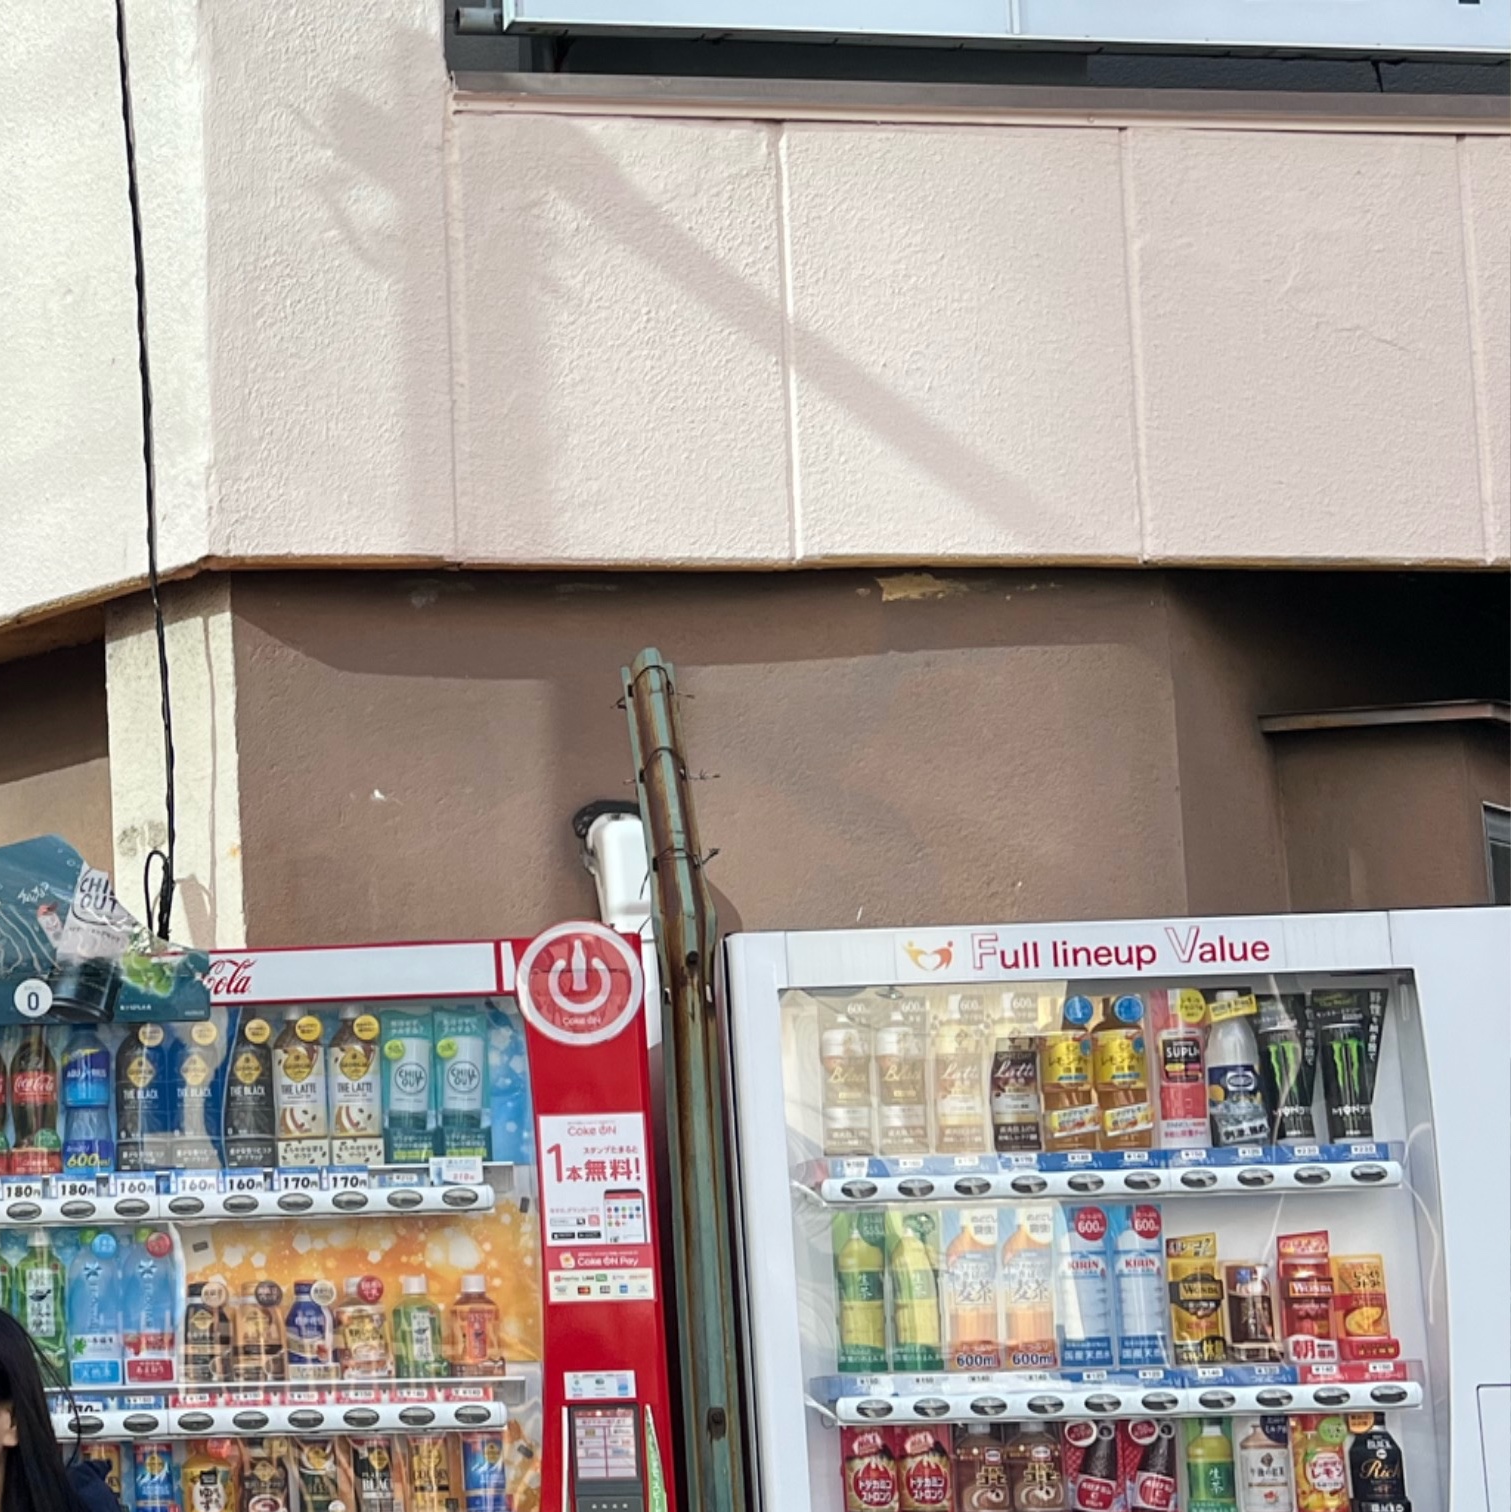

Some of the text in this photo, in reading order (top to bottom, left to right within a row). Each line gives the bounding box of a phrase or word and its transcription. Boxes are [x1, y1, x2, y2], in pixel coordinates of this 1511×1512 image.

[970, 926, 1271, 972] Full lineup Value
[28, 992, 40, 1011] 0
[1370, 990, 1381, 1062] 野性を解き放て
[398, 1069, 426, 1080] CHILL
[450, 1068, 478, 1079] CHILL
[995, 1060, 1034, 1079] Latte
[14, 1074, 55, 1093] Coca-Cola
[281, 1083, 317, 1095] THE LATTE
[338, 1082, 373, 1094] THE LATTE
[244, 1086, 265, 1097] BLACK
[567, 1124, 617, 1137] Coke ON
[547, 1143, 640, 1183] 1本無料!
[120, 1182, 154, 1193] 160円
[181, 1179, 215, 1191] 160円
[229, 1179, 263, 1190] 160円
[283, 1177, 318, 1188] 170円
[332, 1176, 366, 1187] 170円
[6, 1185, 40, 1197] 180円
[61, 1184, 95, 1195] 180円
[577, 1257, 602, 1267] Coke
[620, 1256, 639, 1267] Pay
[1067, 1261, 1099, 1271] KIRIN
[1125, 1259, 1155, 1269] KIRIN
[958, 1281, 993, 1301] 麦茶
[1014, 1280, 1049, 1300] 麦茶
[1182, 1285, 1219, 1295] WONDA
[1293, 1282, 1332, 1293] WONDA
[1293, 1340, 1315, 1359] 朝
[956, 1354, 997, 1367] 600ml
[1012, 1354, 1053, 1367] 600ml
[1312, 1466, 1342, 1479] レモン
[1361, 1460, 1400, 1478] Rich
[1209, 1468, 1223, 1494] 生茶
[862, 1492, 891, 1502] ストロング
[913, 1490, 944, 1501] ストロング
